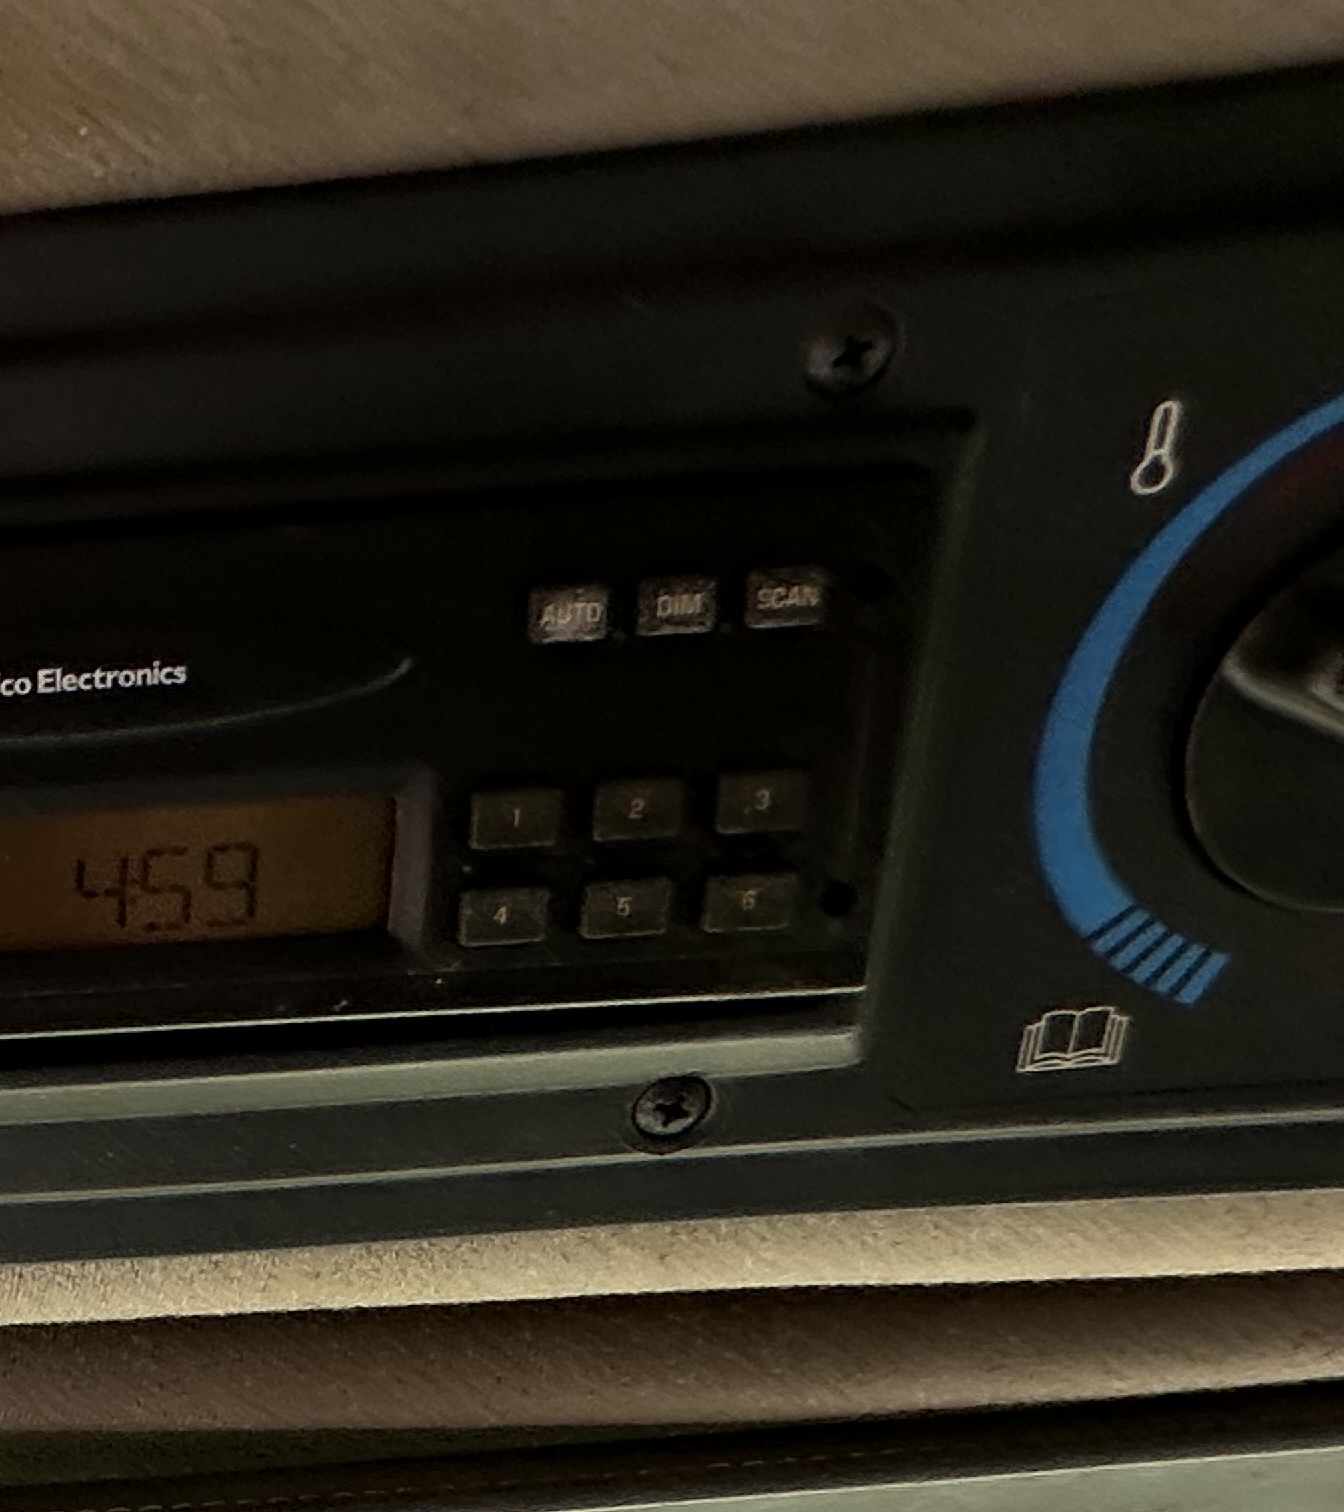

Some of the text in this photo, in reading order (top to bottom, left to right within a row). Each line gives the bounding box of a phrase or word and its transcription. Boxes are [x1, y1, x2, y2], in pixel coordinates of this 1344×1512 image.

[756, 584, 819, 610] SCAN
[539, 601, 602, 628] AUTO
[37, 660, 187, 694] Electronics
[627, 796, 646, 821] 2
[752, 788, 772, 812] 3
[510, 806, 522, 829] 1
[491, 904, 509, 926] 4
[615, 895, 633, 917] 5
